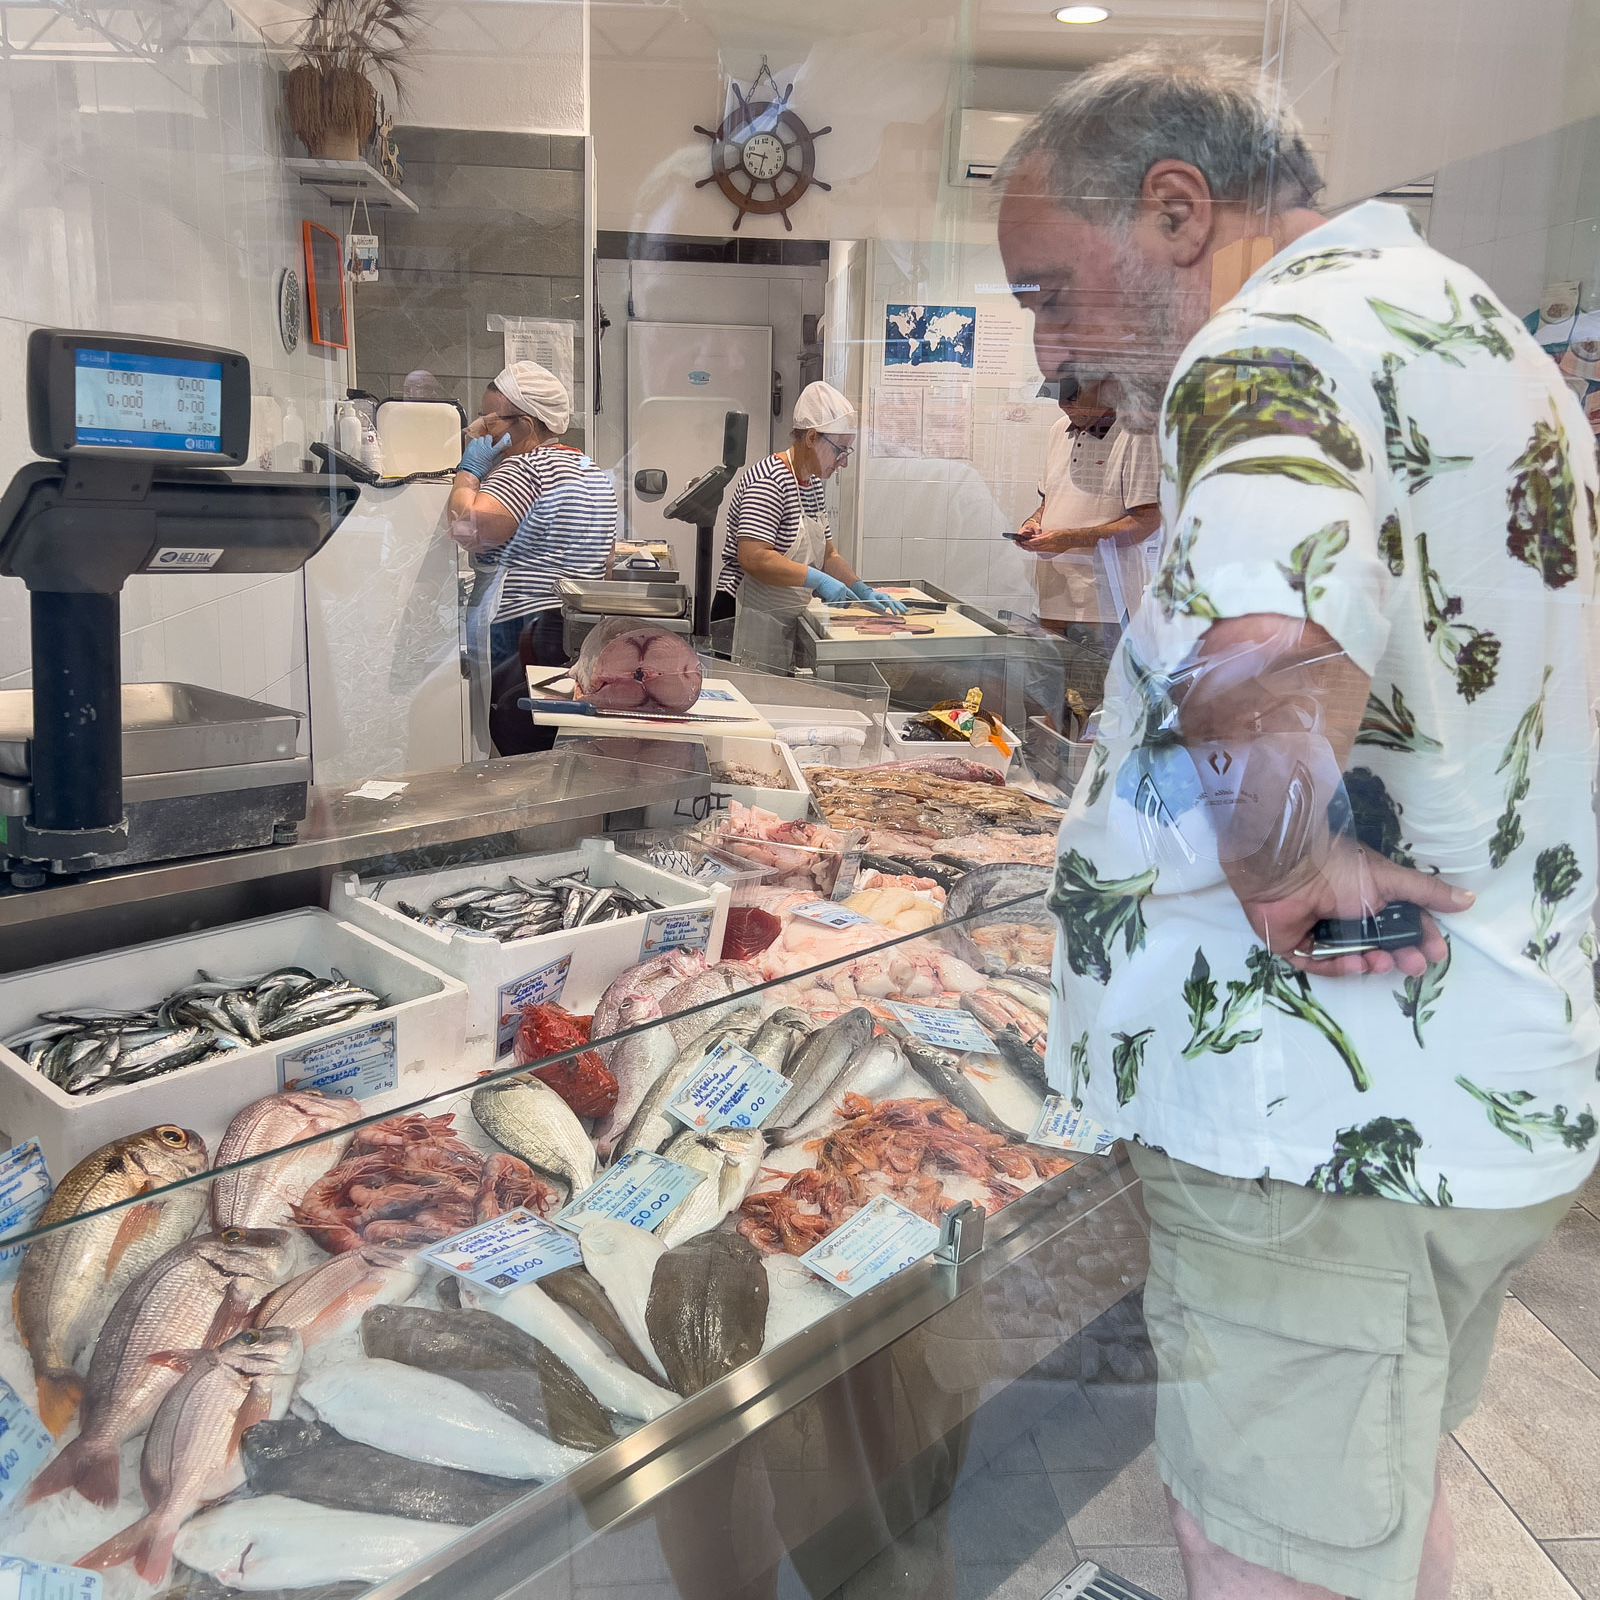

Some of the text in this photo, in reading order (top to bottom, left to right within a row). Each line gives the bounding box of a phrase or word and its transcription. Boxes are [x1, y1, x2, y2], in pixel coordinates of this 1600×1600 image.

[308, 1040, 345, 1056] Pescheria
[374, 1080, 393, 1091] al kg
[583, 1182, 610, 1207] Pescheria
[587, 1189, 613, 1211] ORATA
[630, 1193, 670, 1228] 50.00
[829, 1228, 857, 1250] Pescheria
[81, 1576, 96, 1589] kg
